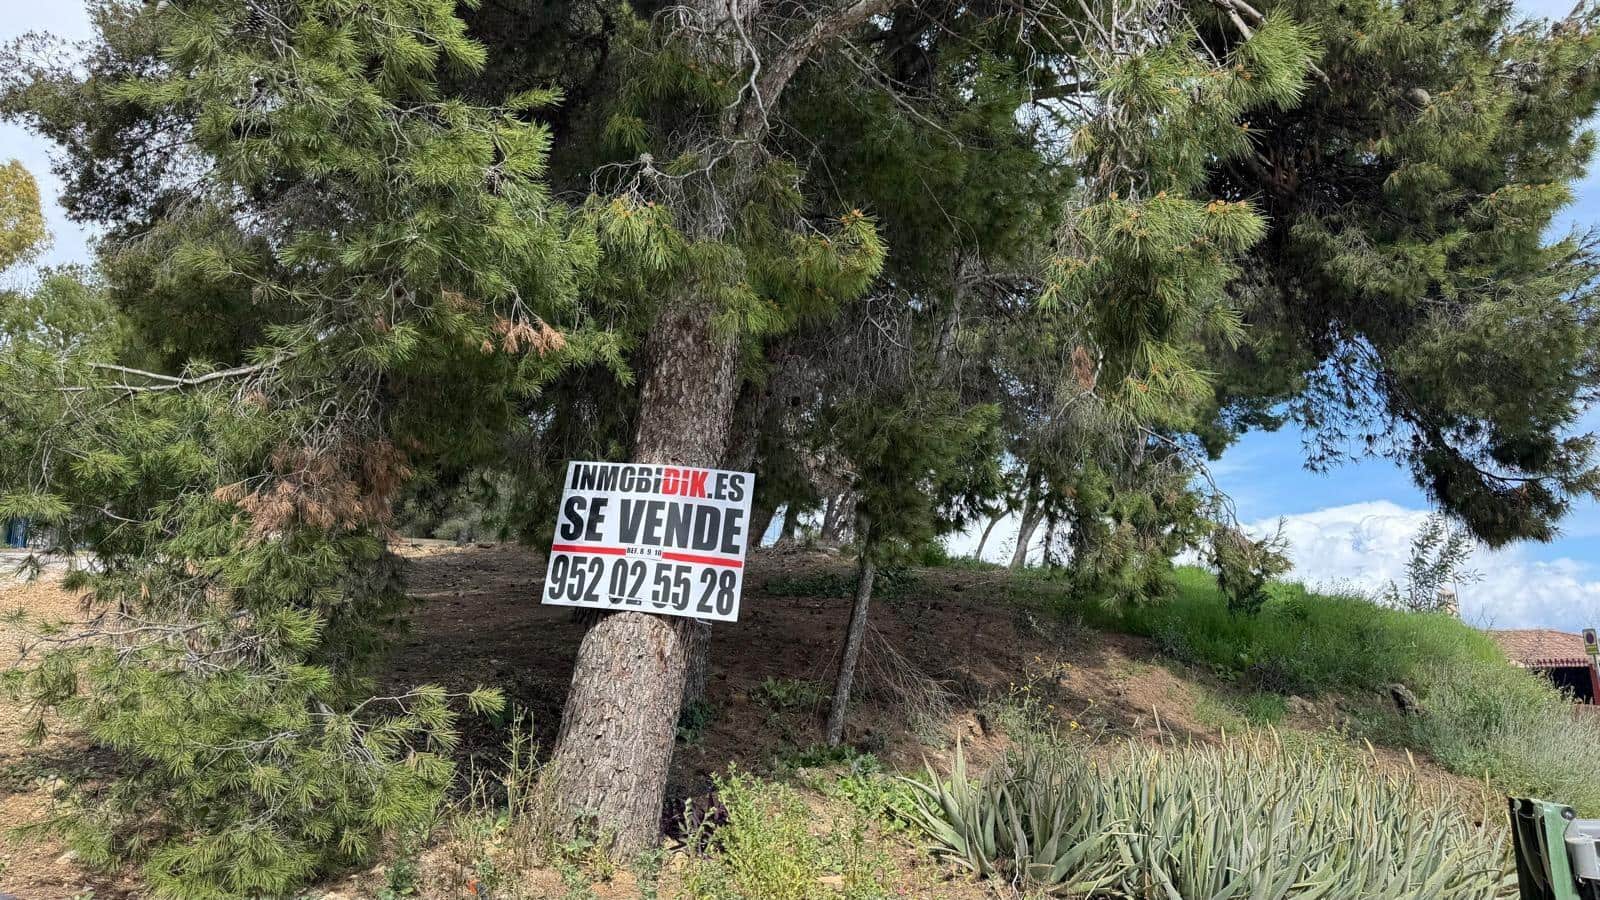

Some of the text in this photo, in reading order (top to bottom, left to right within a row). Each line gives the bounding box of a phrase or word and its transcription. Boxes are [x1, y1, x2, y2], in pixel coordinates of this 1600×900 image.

[560, 495, 744, 554] SE VENDE
[549, 554, 737, 616] 952 02 55 28
